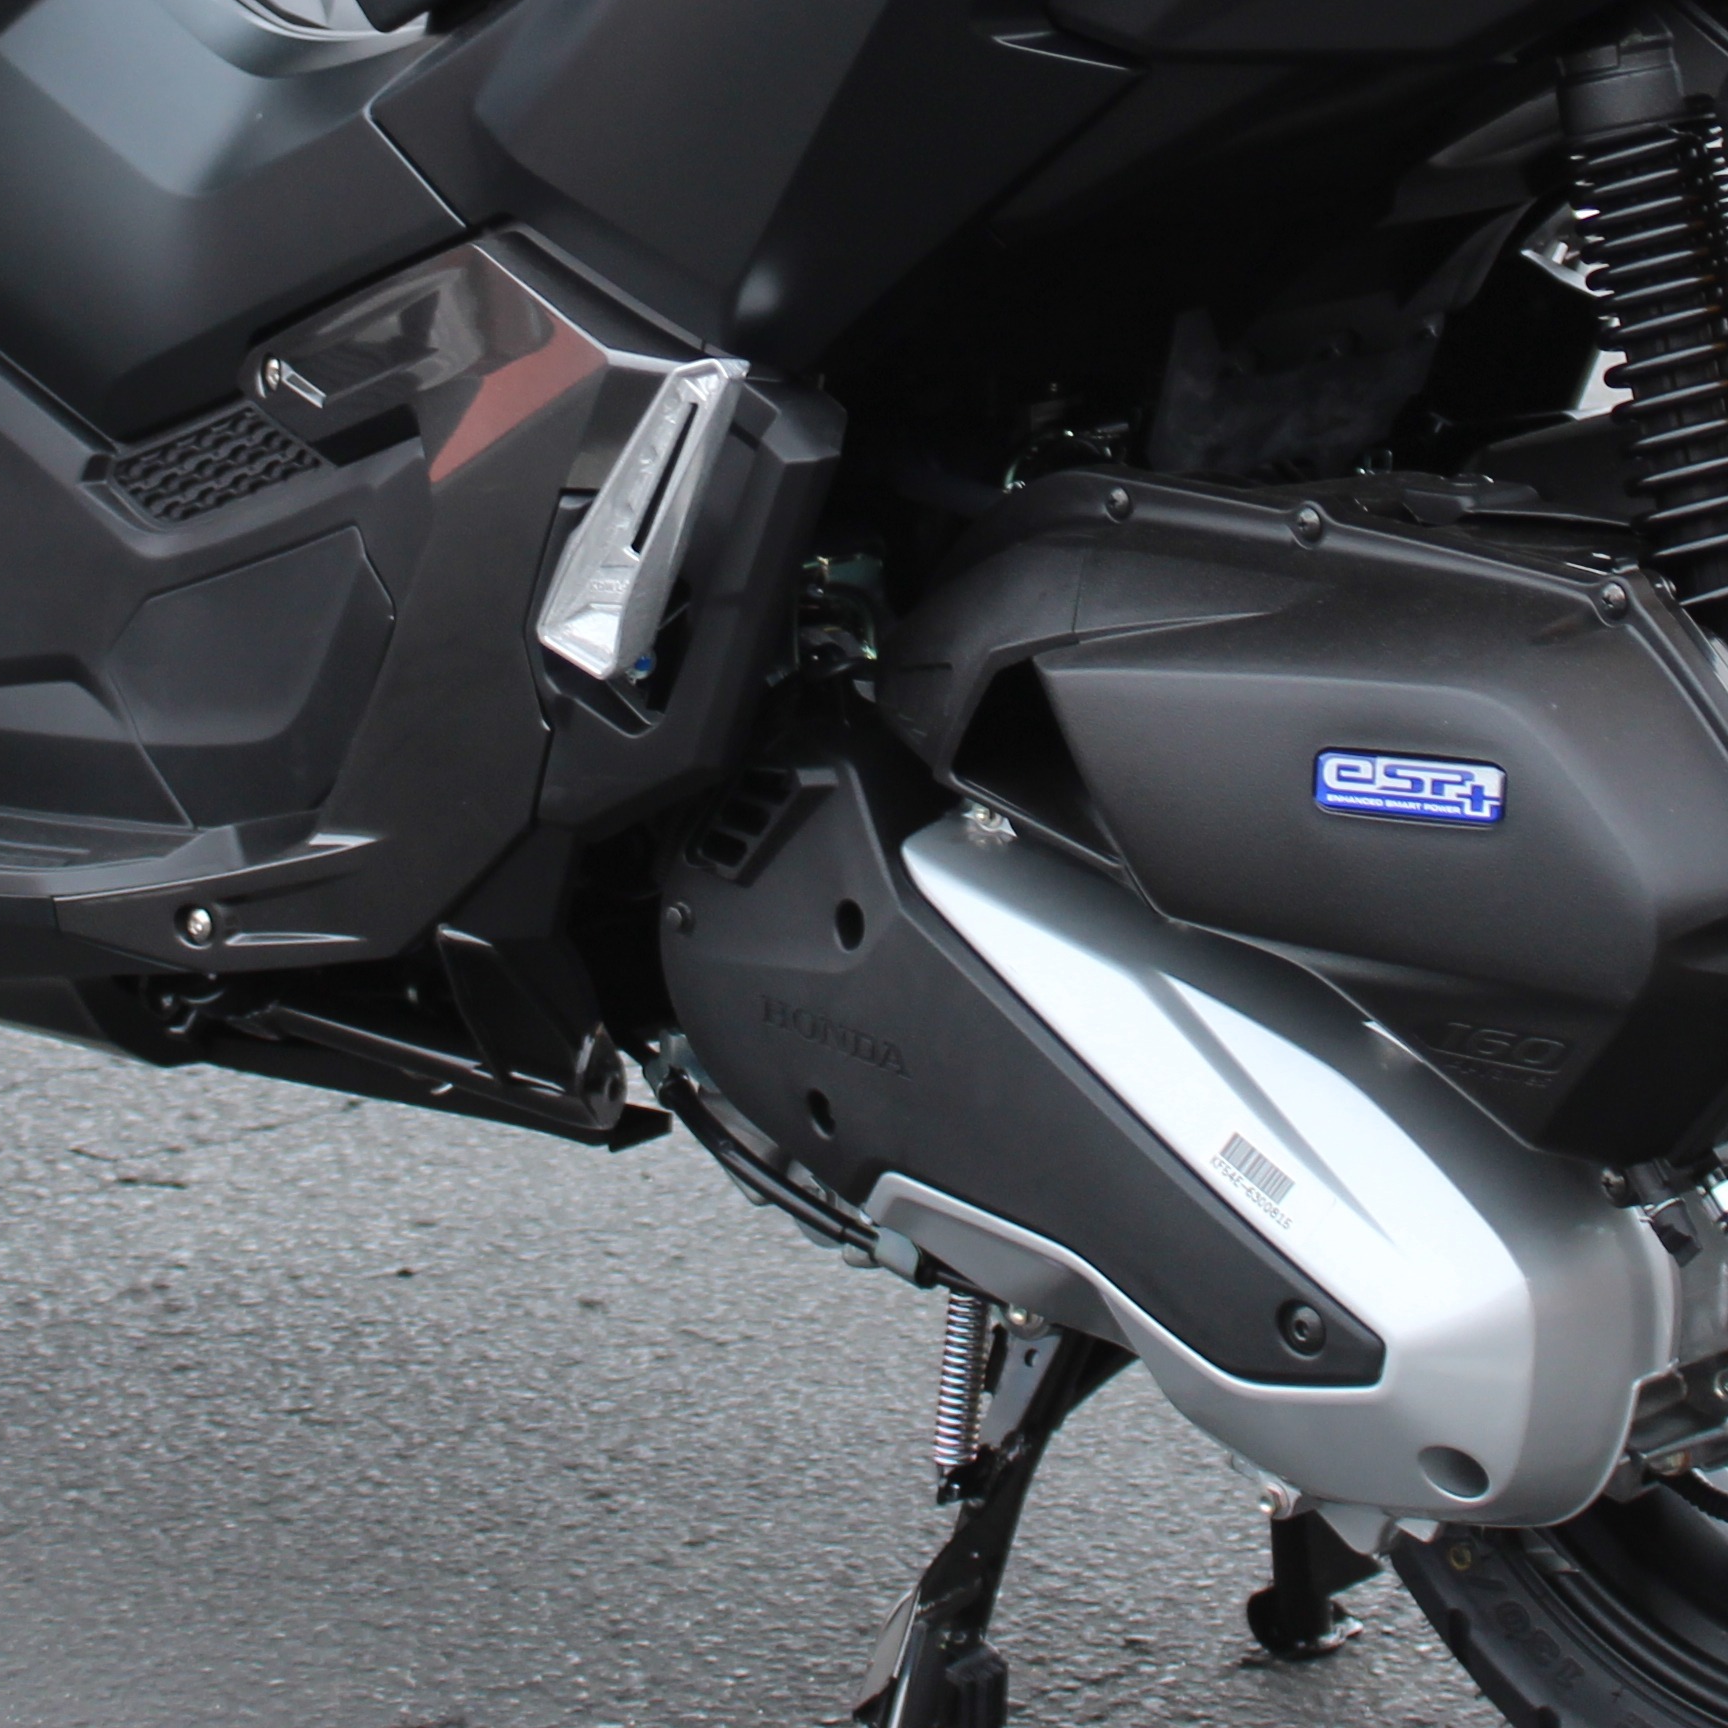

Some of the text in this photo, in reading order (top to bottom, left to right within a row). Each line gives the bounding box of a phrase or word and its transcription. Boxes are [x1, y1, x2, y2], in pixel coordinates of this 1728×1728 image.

[1327, 794, 1461, 814] ENHANCED SMART POWER
[763, 1000, 913, 1080] HONDA
[1442, 1022, 1568, 1066] 160
[1208, 1154, 1294, 1231] KF54E-6300815
